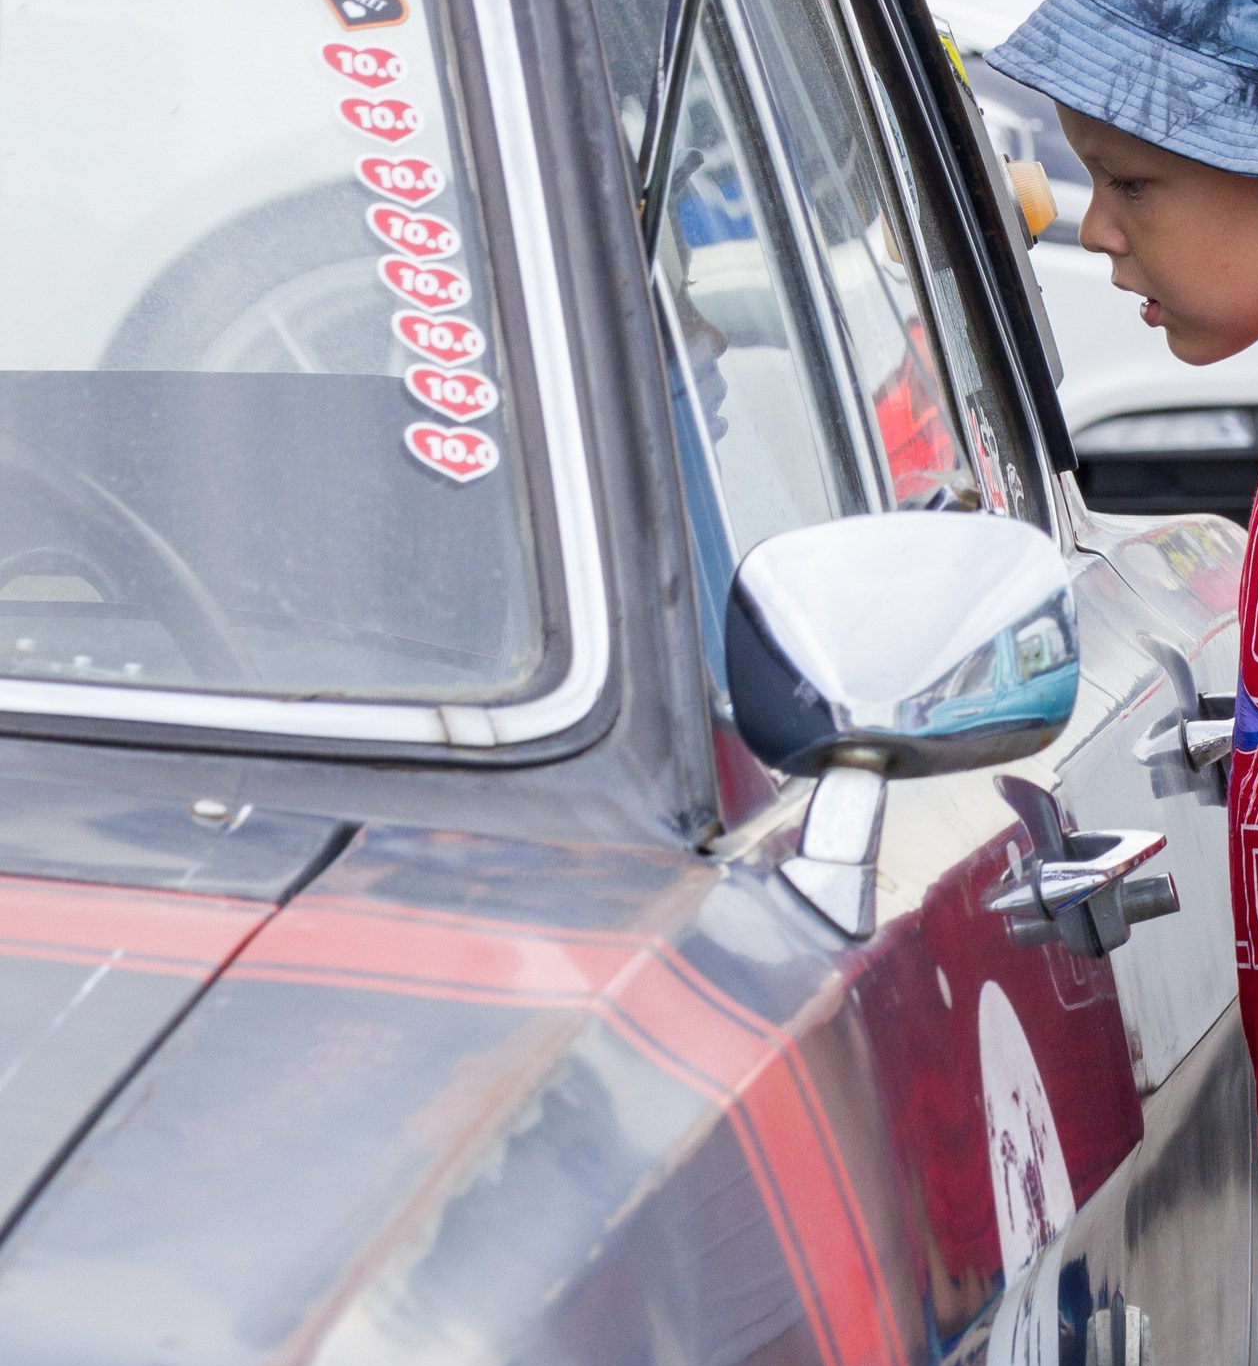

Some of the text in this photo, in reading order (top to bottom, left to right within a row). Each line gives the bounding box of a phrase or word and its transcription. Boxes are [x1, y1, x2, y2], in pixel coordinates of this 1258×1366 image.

[337, 51, 406, 79] 10.0
[354, 105, 423, 131] 10.0
[375, 165, 444, 190] 10.0
[388, 216, 459, 252] 10.0
[398, 267, 470, 302] 10.0
[412, 323, 485, 355] 10.0
[425, 377, 496, 407] 10.0
[425, 436, 497, 466] 10.0
